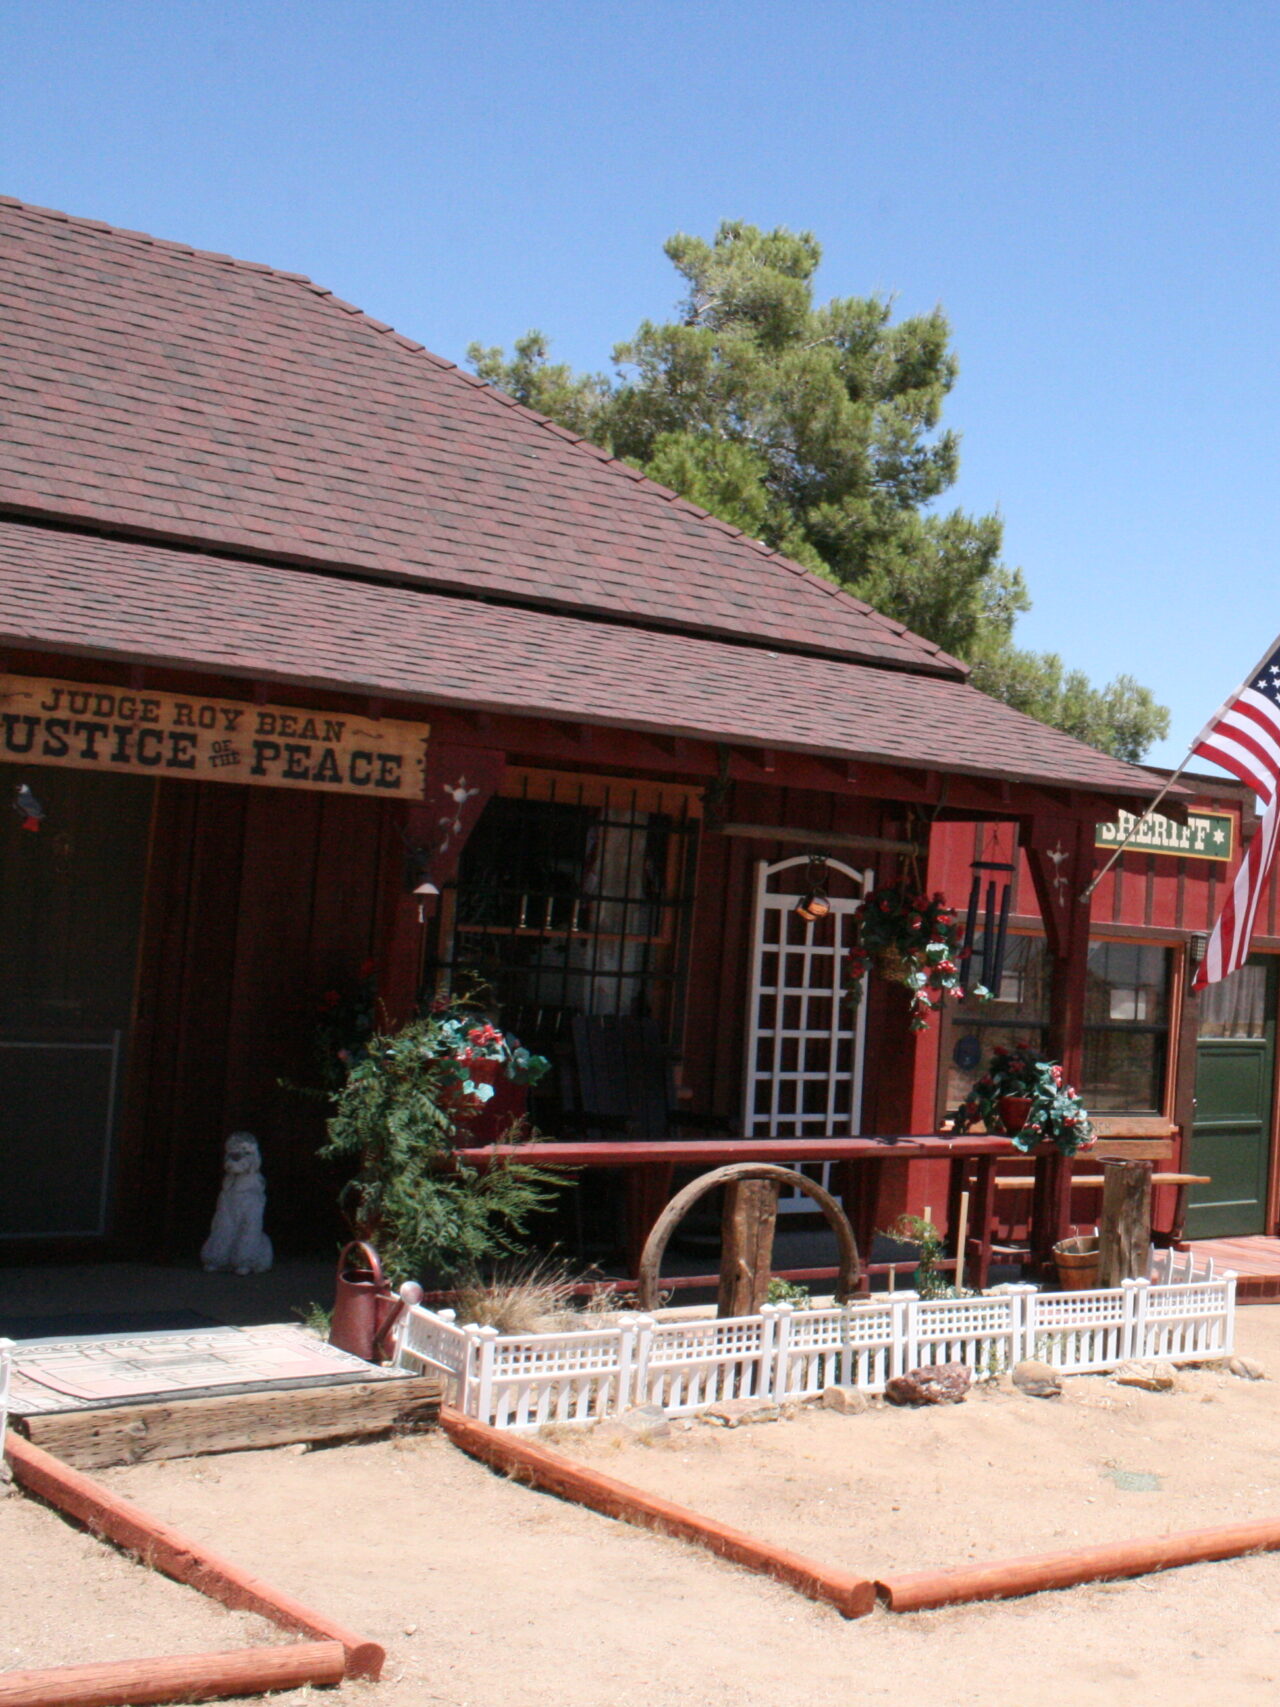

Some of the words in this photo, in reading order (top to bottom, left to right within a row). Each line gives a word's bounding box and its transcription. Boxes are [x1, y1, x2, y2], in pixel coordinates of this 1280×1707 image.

[40, 687, 162, 724] JUDGE
[172, 702, 244, 732] ROY
[255, 711, 347, 743] BEAN
[0, 713, 198, 770] USTICE
[208, 751, 241, 768] THE
[211, 739, 232, 754] OF
[251, 739, 403, 789] PEACE
